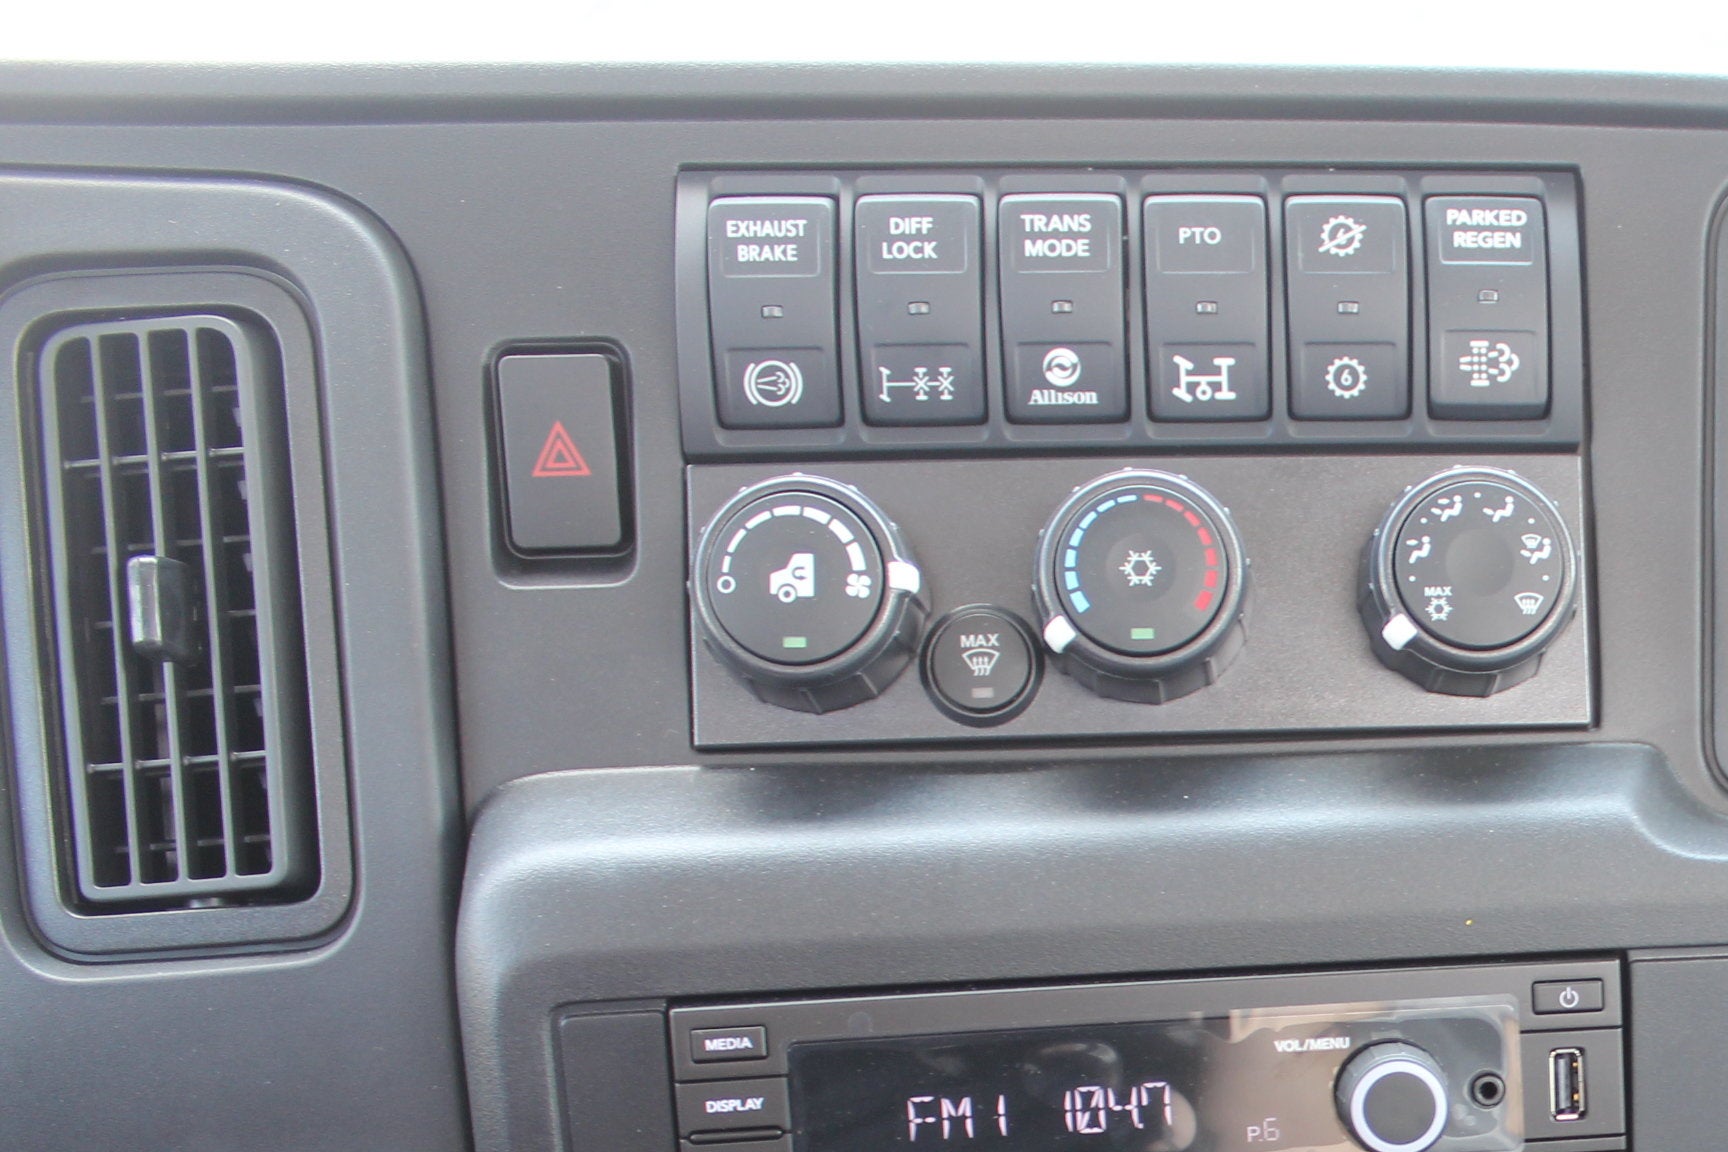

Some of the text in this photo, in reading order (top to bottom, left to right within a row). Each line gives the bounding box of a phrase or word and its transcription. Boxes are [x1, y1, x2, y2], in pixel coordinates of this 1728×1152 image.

[890, 217, 933, 234] DIFF
[1020, 214, 1091, 232] TRANS
[1447, 209, 1527, 226] PARKED
[726, 220, 807, 237] EXHAUST
[1179, 227, 1221, 244] PTO
[1025, 239, 1090, 257] MODE
[1453, 231, 1521, 248] REGEN
[737, 244, 798, 261] BRAKE
[882, 241, 937, 259] LOCK
[1029, 388, 1098, 404] Allison
[1424, 587, 1452, 598] MAX
[960, 634, 999, 648] MAX
[705, 1037, 752, 1050] MEDIA
[1273, 1037, 1349, 1052] VOL/MENU
[706, 1098, 763, 1113] DISPLAY
